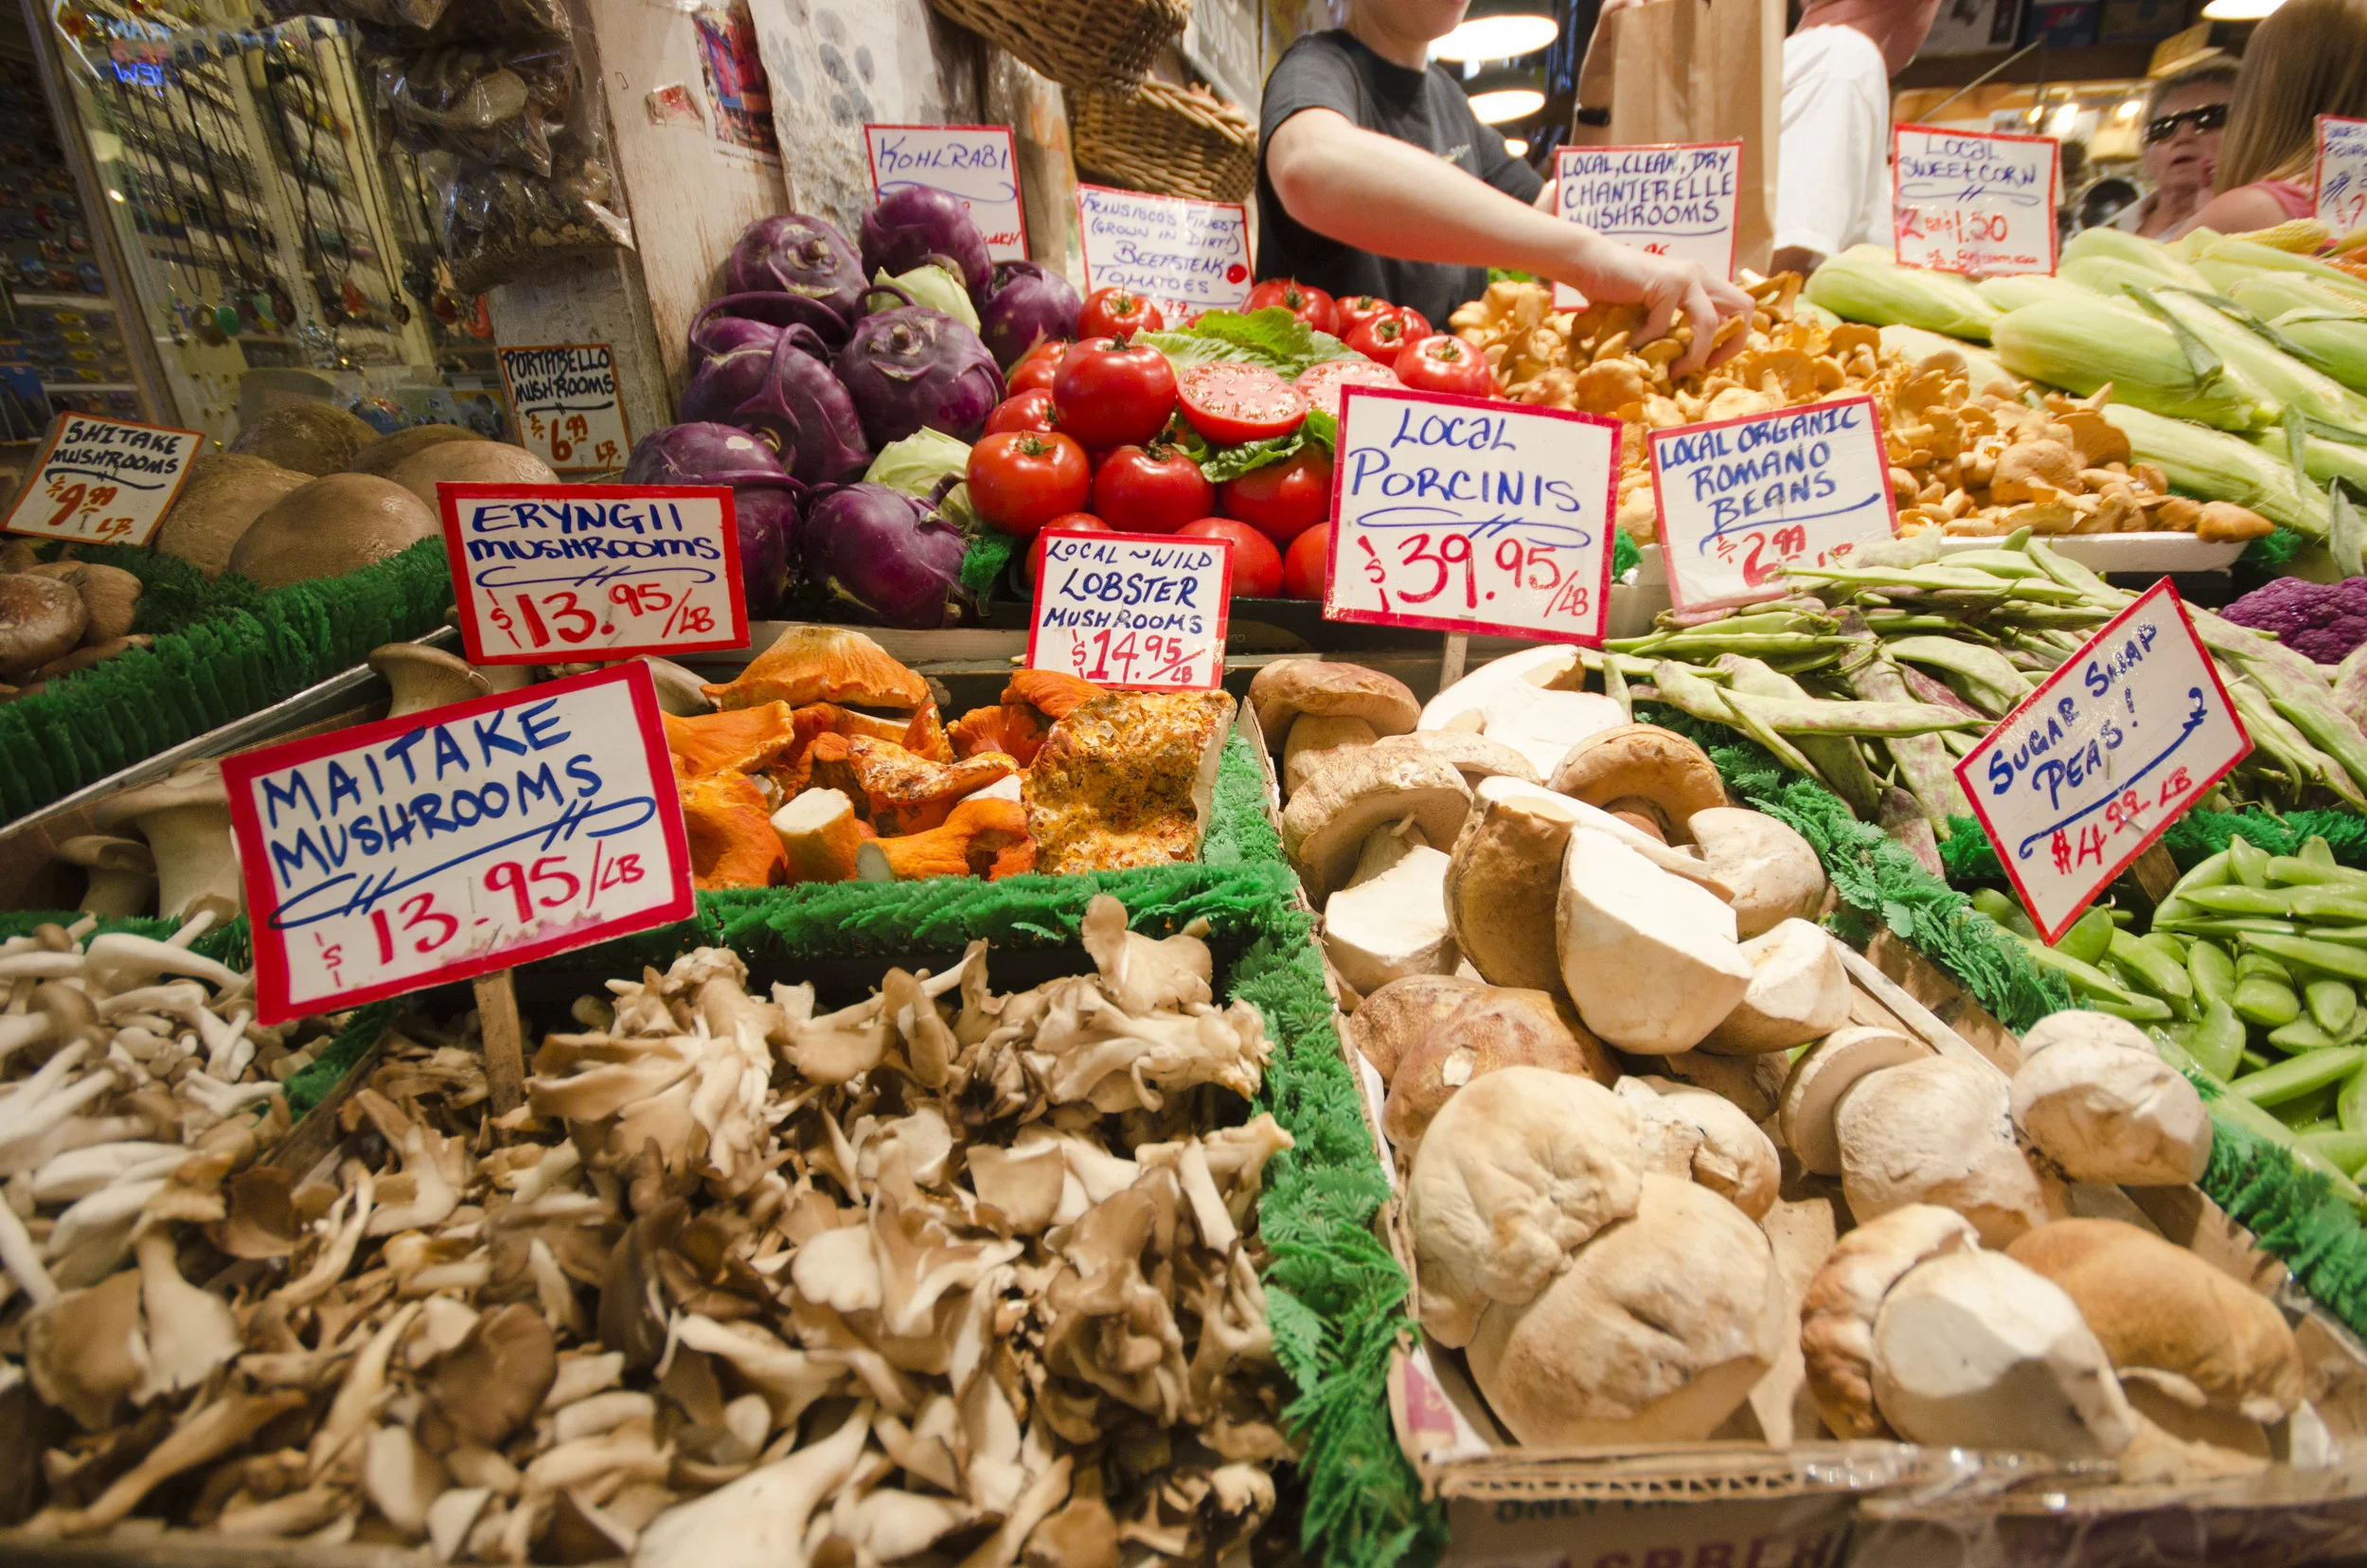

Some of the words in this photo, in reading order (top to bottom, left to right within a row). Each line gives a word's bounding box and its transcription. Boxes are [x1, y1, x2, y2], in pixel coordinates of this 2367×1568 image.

[879, 135, 1007, 173] KOHLRABI
[1564, 171, 1734, 209] CHANTERELLE
[1159, 230, 1177, 241] IN
[1090, 263, 1209, 294] TOMATOES
[1112, 240, 1225, 279] BEEFSTEAK
[502, 347, 611, 382] PORTABELLO
[514, 373, 615, 406] MUSHROOMS
[64, 420, 182, 455] SHITAKE
[1660, 430, 1733, 472] LOCAL
[1737, 405, 1862, 454] ORGANIC
[48, 448, 180, 474] MUSHROOMS
[1348, 447, 1581, 512] PORCINIS
[1687, 439, 1831, 502] ROMANO
[472, 501, 683, 534] ERYNGII
[1707, 469, 1837, 532] BEANS
[466, 536, 721, 561] MUSHROOMS
[1046, 540, 1118, 564] LOCAL
[1059, 568, 1199, 609] LOBSTER
[1042, 607, 1203, 634] MUSHROOMS
[1988, 696, 2080, 795] SUGAR
[2085, 623, 2159, 698] SNAP
[261, 697, 572, 830] MAITAKE
[270, 754, 603, 889] MUSHROOMS
